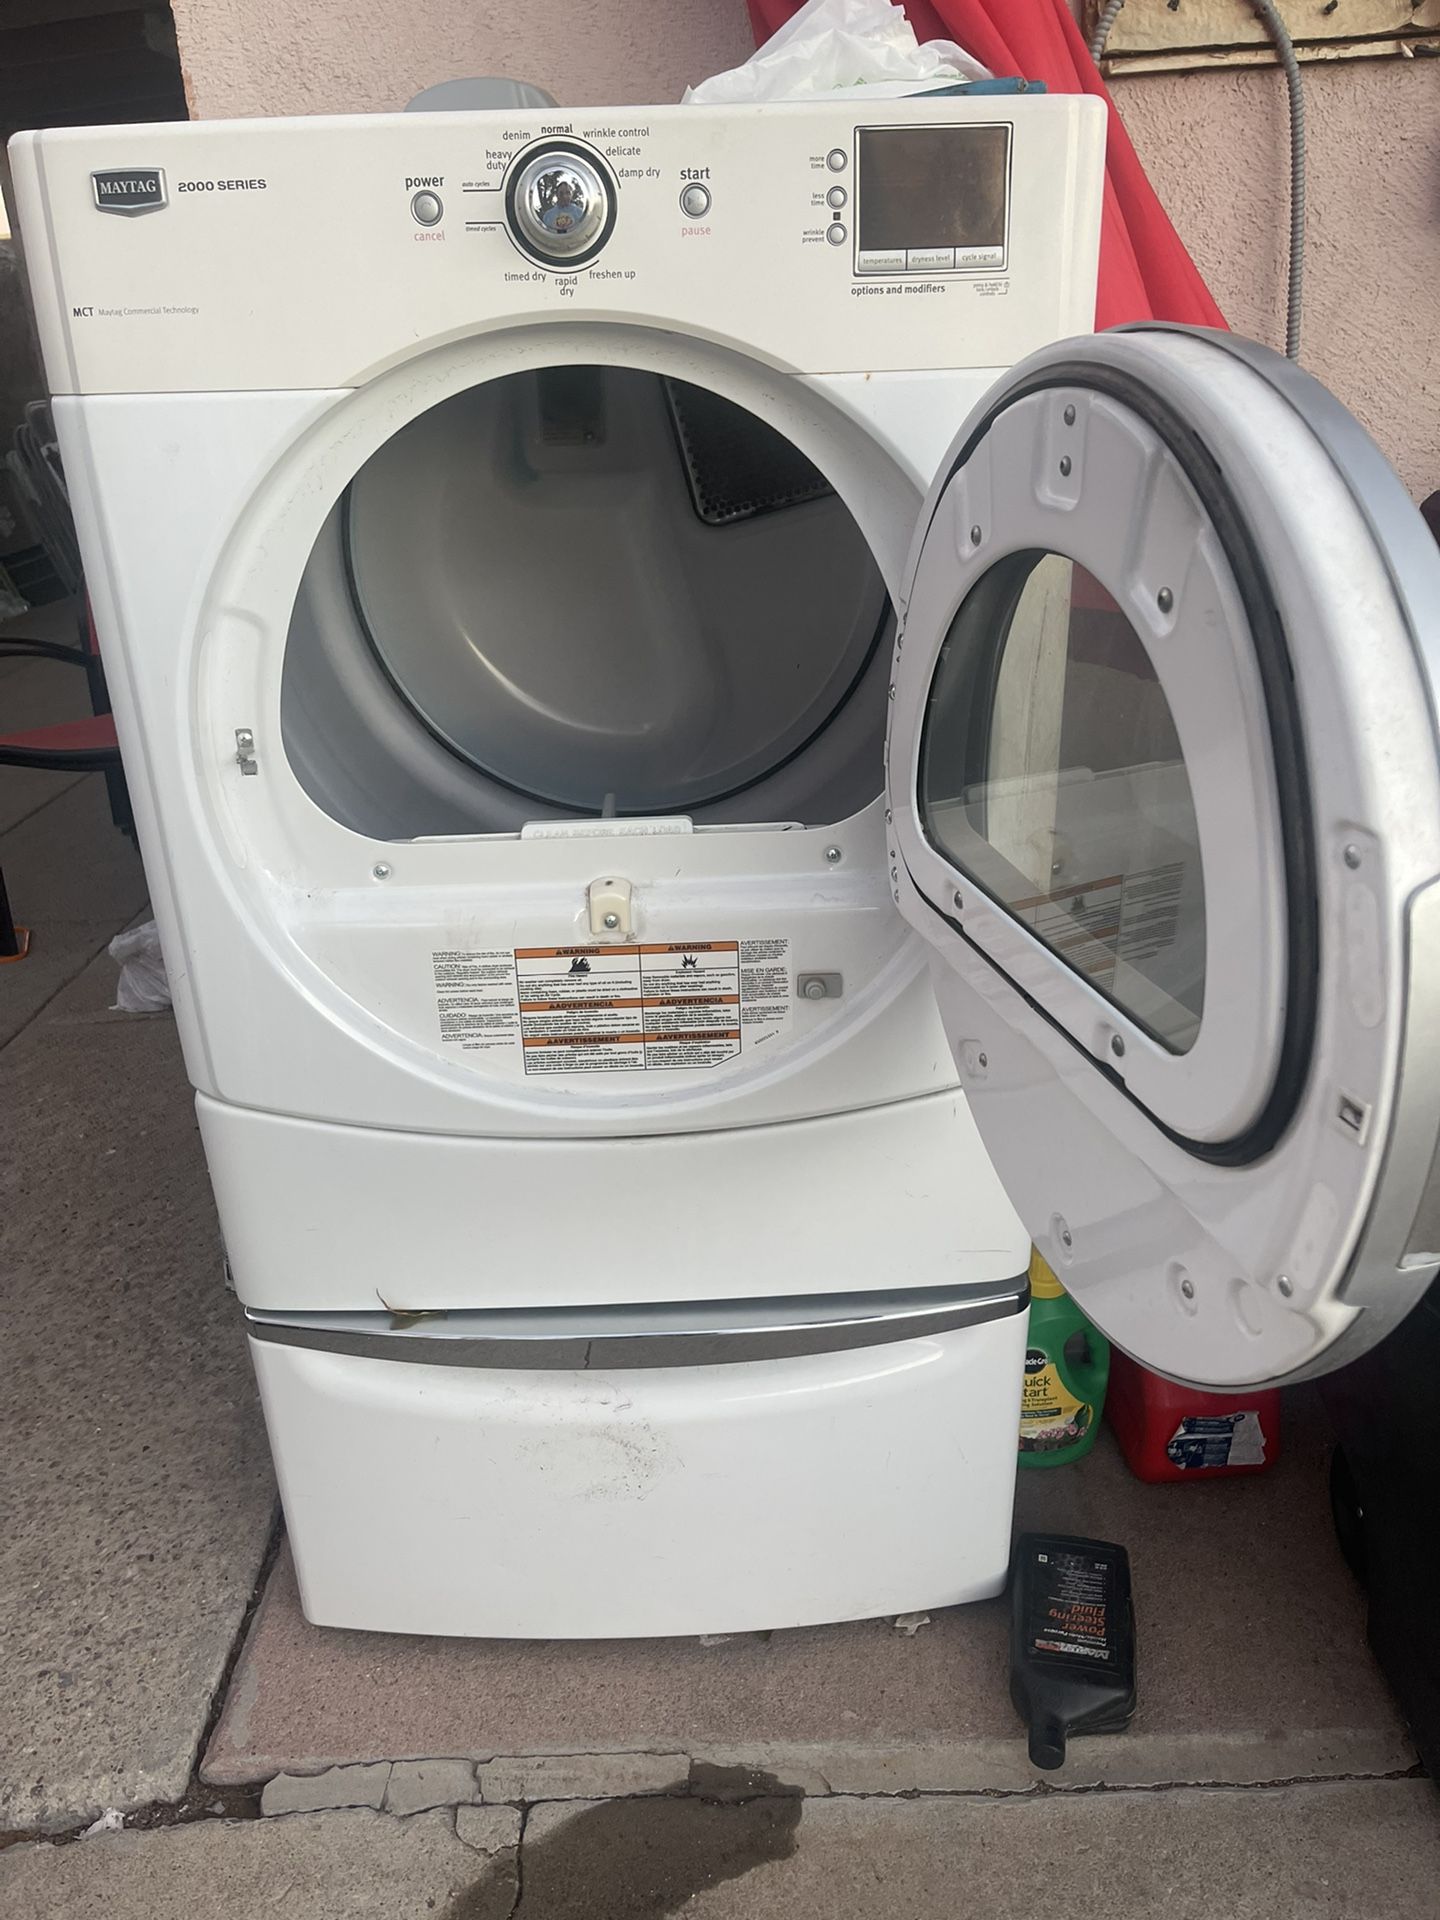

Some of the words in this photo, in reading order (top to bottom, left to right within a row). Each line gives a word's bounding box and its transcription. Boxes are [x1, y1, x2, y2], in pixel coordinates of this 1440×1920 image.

[503, 130, 531, 140] denim
[541, 124, 573, 134] normal
[583, 128, 617, 138] wrinkle
[618, 126, 649, 138] control
[486, 150, 513, 161] heavy
[605, 146, 641, 156] delicate
[486, 160, 507, 171] duty
[619, 168, 644, 180] damp
[645, 167, 661, 178] dry
[680, 167, 711, 180] start
[100, 178, 156, 195] MAYTAG
[178, 181, 215, 192] 2000
[217, 179, 267, 191] SERIES
[405, 175, 445, 191] power
[414, 230, 446, 242] cancel
[681, 225, 711, 238] pause
[863, 256, 903, 265] temperatures
[911, 255, 935, 264] dryness
[936, 254, 951, 262] level
[961, 254, 977, 262] cycle
[978, 252, 997, 261] signal
[504, 271, 530, 282] timed
[531, 271, 547, 283] dry
[589, 269, 621, 280] freshen
[622, 270, 636, 281] up
[555, 276, 578, 288] rapid
[560, 286, 574, 298] dry
[851, 285, 884, 297] options
[886, 284, 903, 295] and
[904, 283, 946, 294] modifiers
[73, 306, 94, 318] MCT
[98, 308, 123, 317] Maytag
[123, 307, 162, 316] Commercial
[162, 306, 200, 315] Technology
[556, 1001, 614, 1009] ADVERTENCIA
[665, 997, 723, 1005] ADVERTENCIA
[552, 1036, 621, 1044] AVERTISSEMENT
[663, 1032, 729, 1040] AVERTISSEMENT
[1024, 1375, 1051, 1387] uick
[1023, 1387, 1048, 1397] tart
[1071, 1604, 1105, 1617] Fluid
[1048, 1608, 1105, 1626] Steering
[1062, 1623, 1105, 1637] Power
